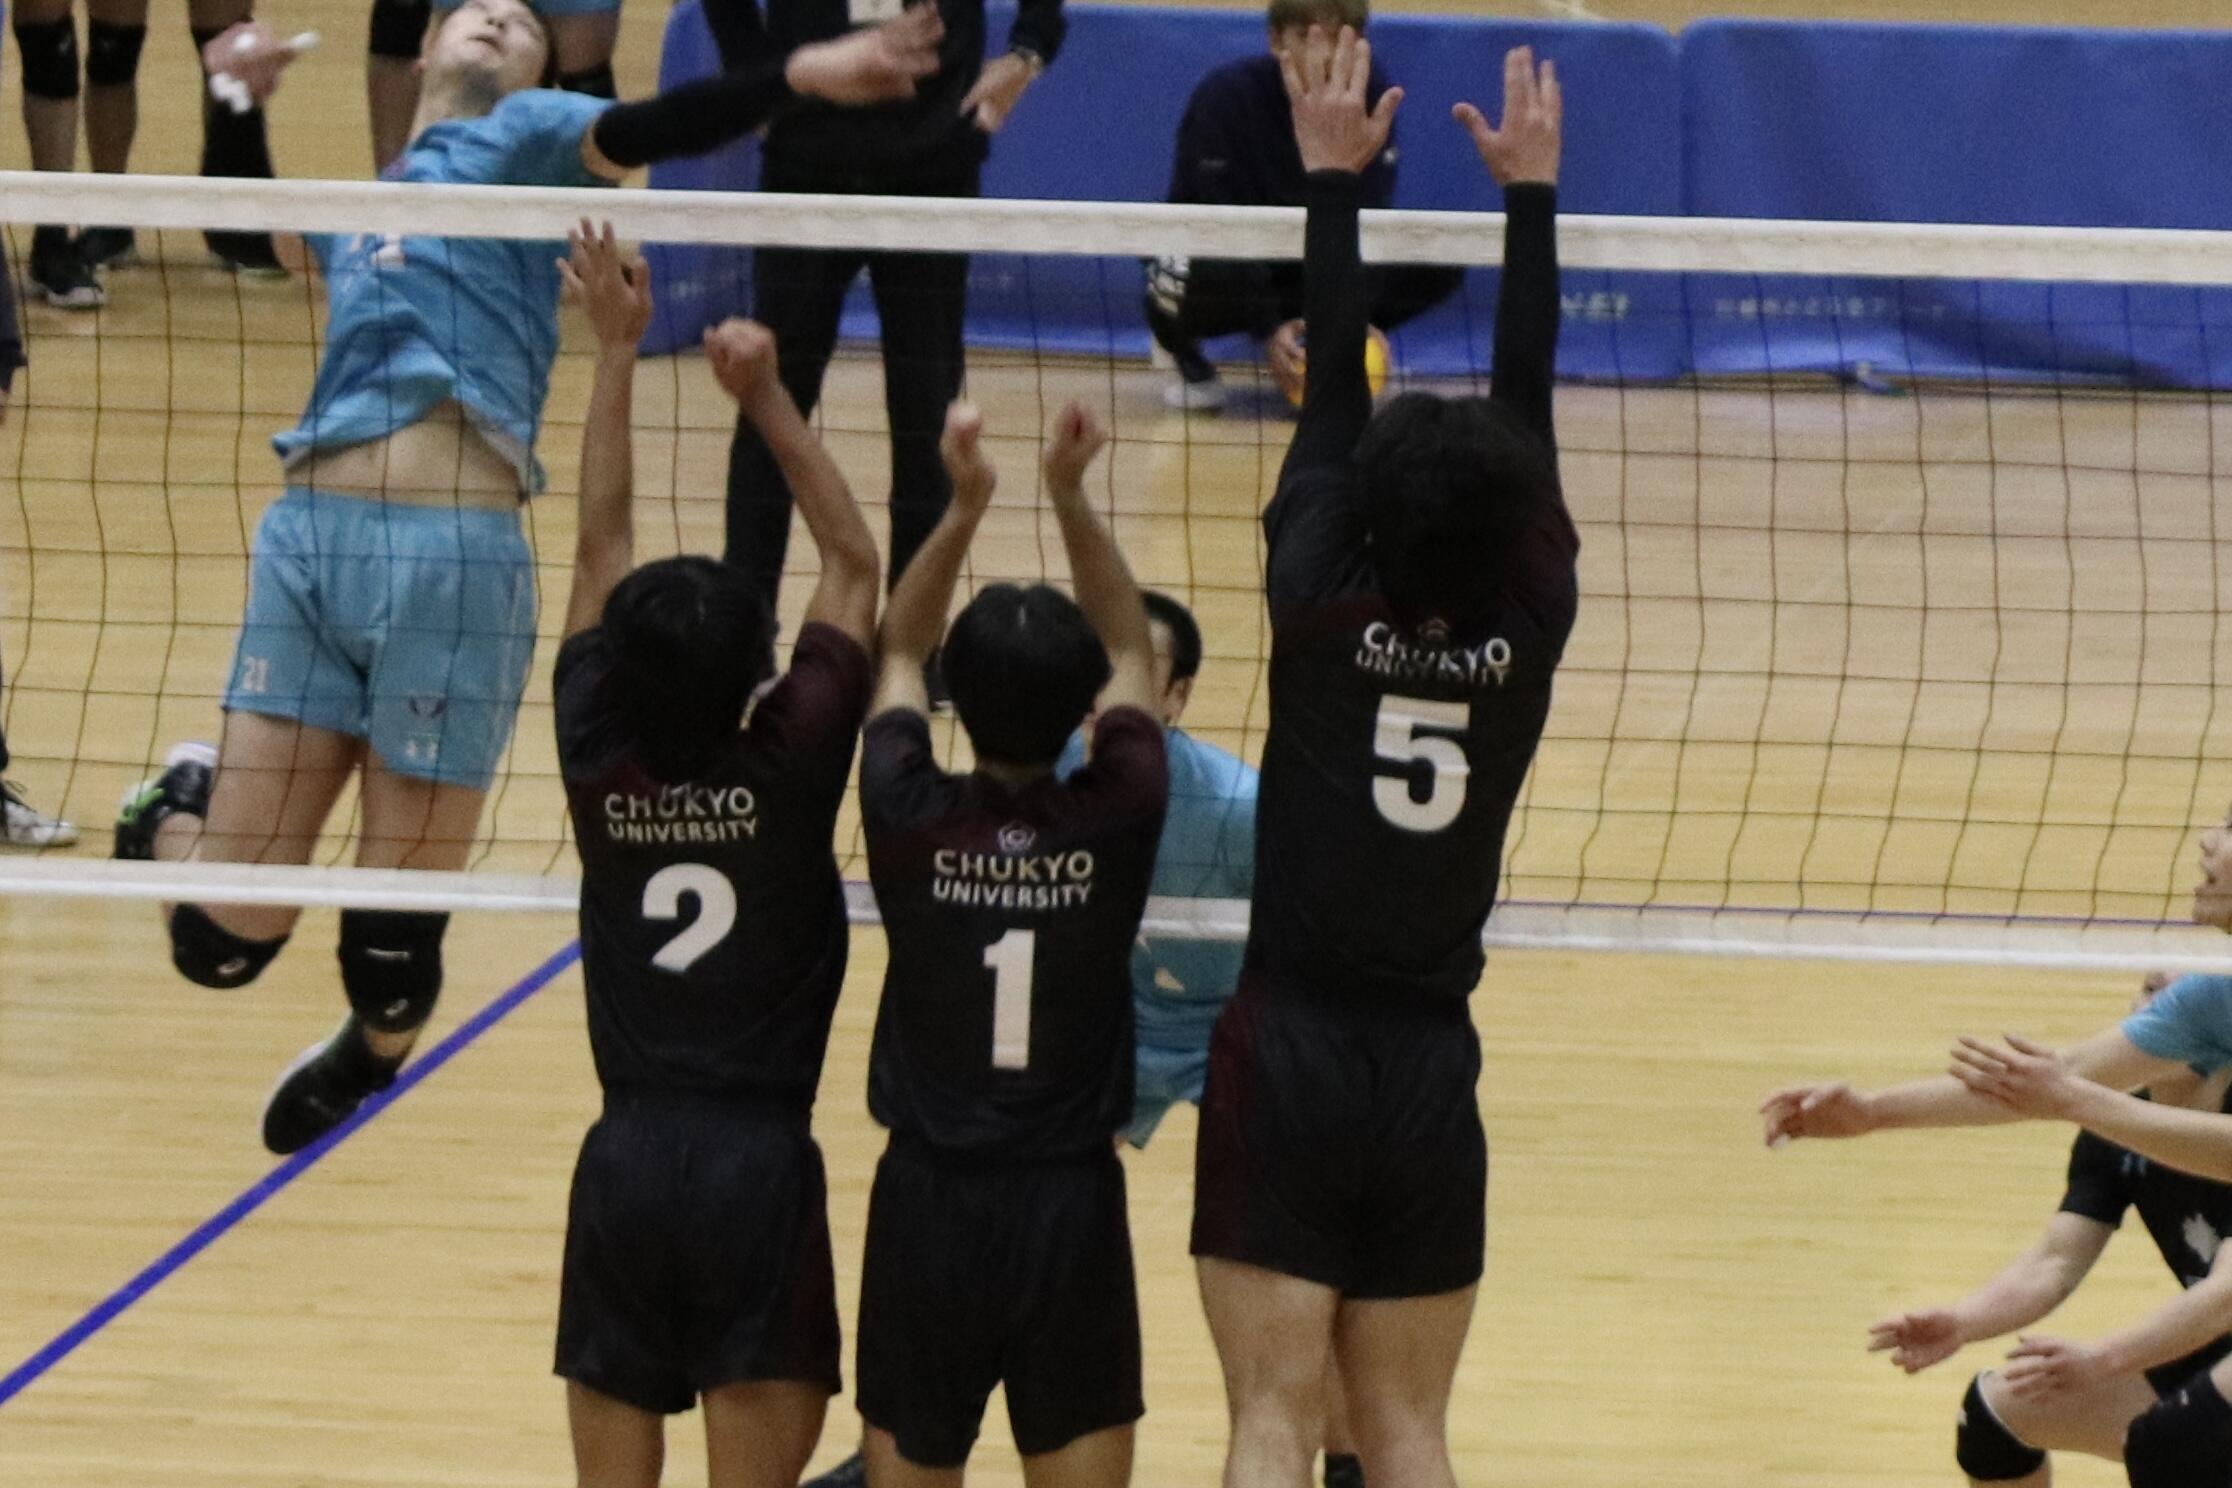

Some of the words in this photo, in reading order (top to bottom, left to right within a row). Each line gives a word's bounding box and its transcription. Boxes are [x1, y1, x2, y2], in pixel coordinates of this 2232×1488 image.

[1372, 694, 1471, 833] 5
[605, 783, 754, 820] CHUKYO
[607, 818, 757, 843] UNIVERSITY
[934, 850, 1094, 882] CHUKYO
[932, 877, 1093, 908] UNIVERSITY
[641, 862, 737, 973] 2
[983, 927, 1036, 1070] 1
